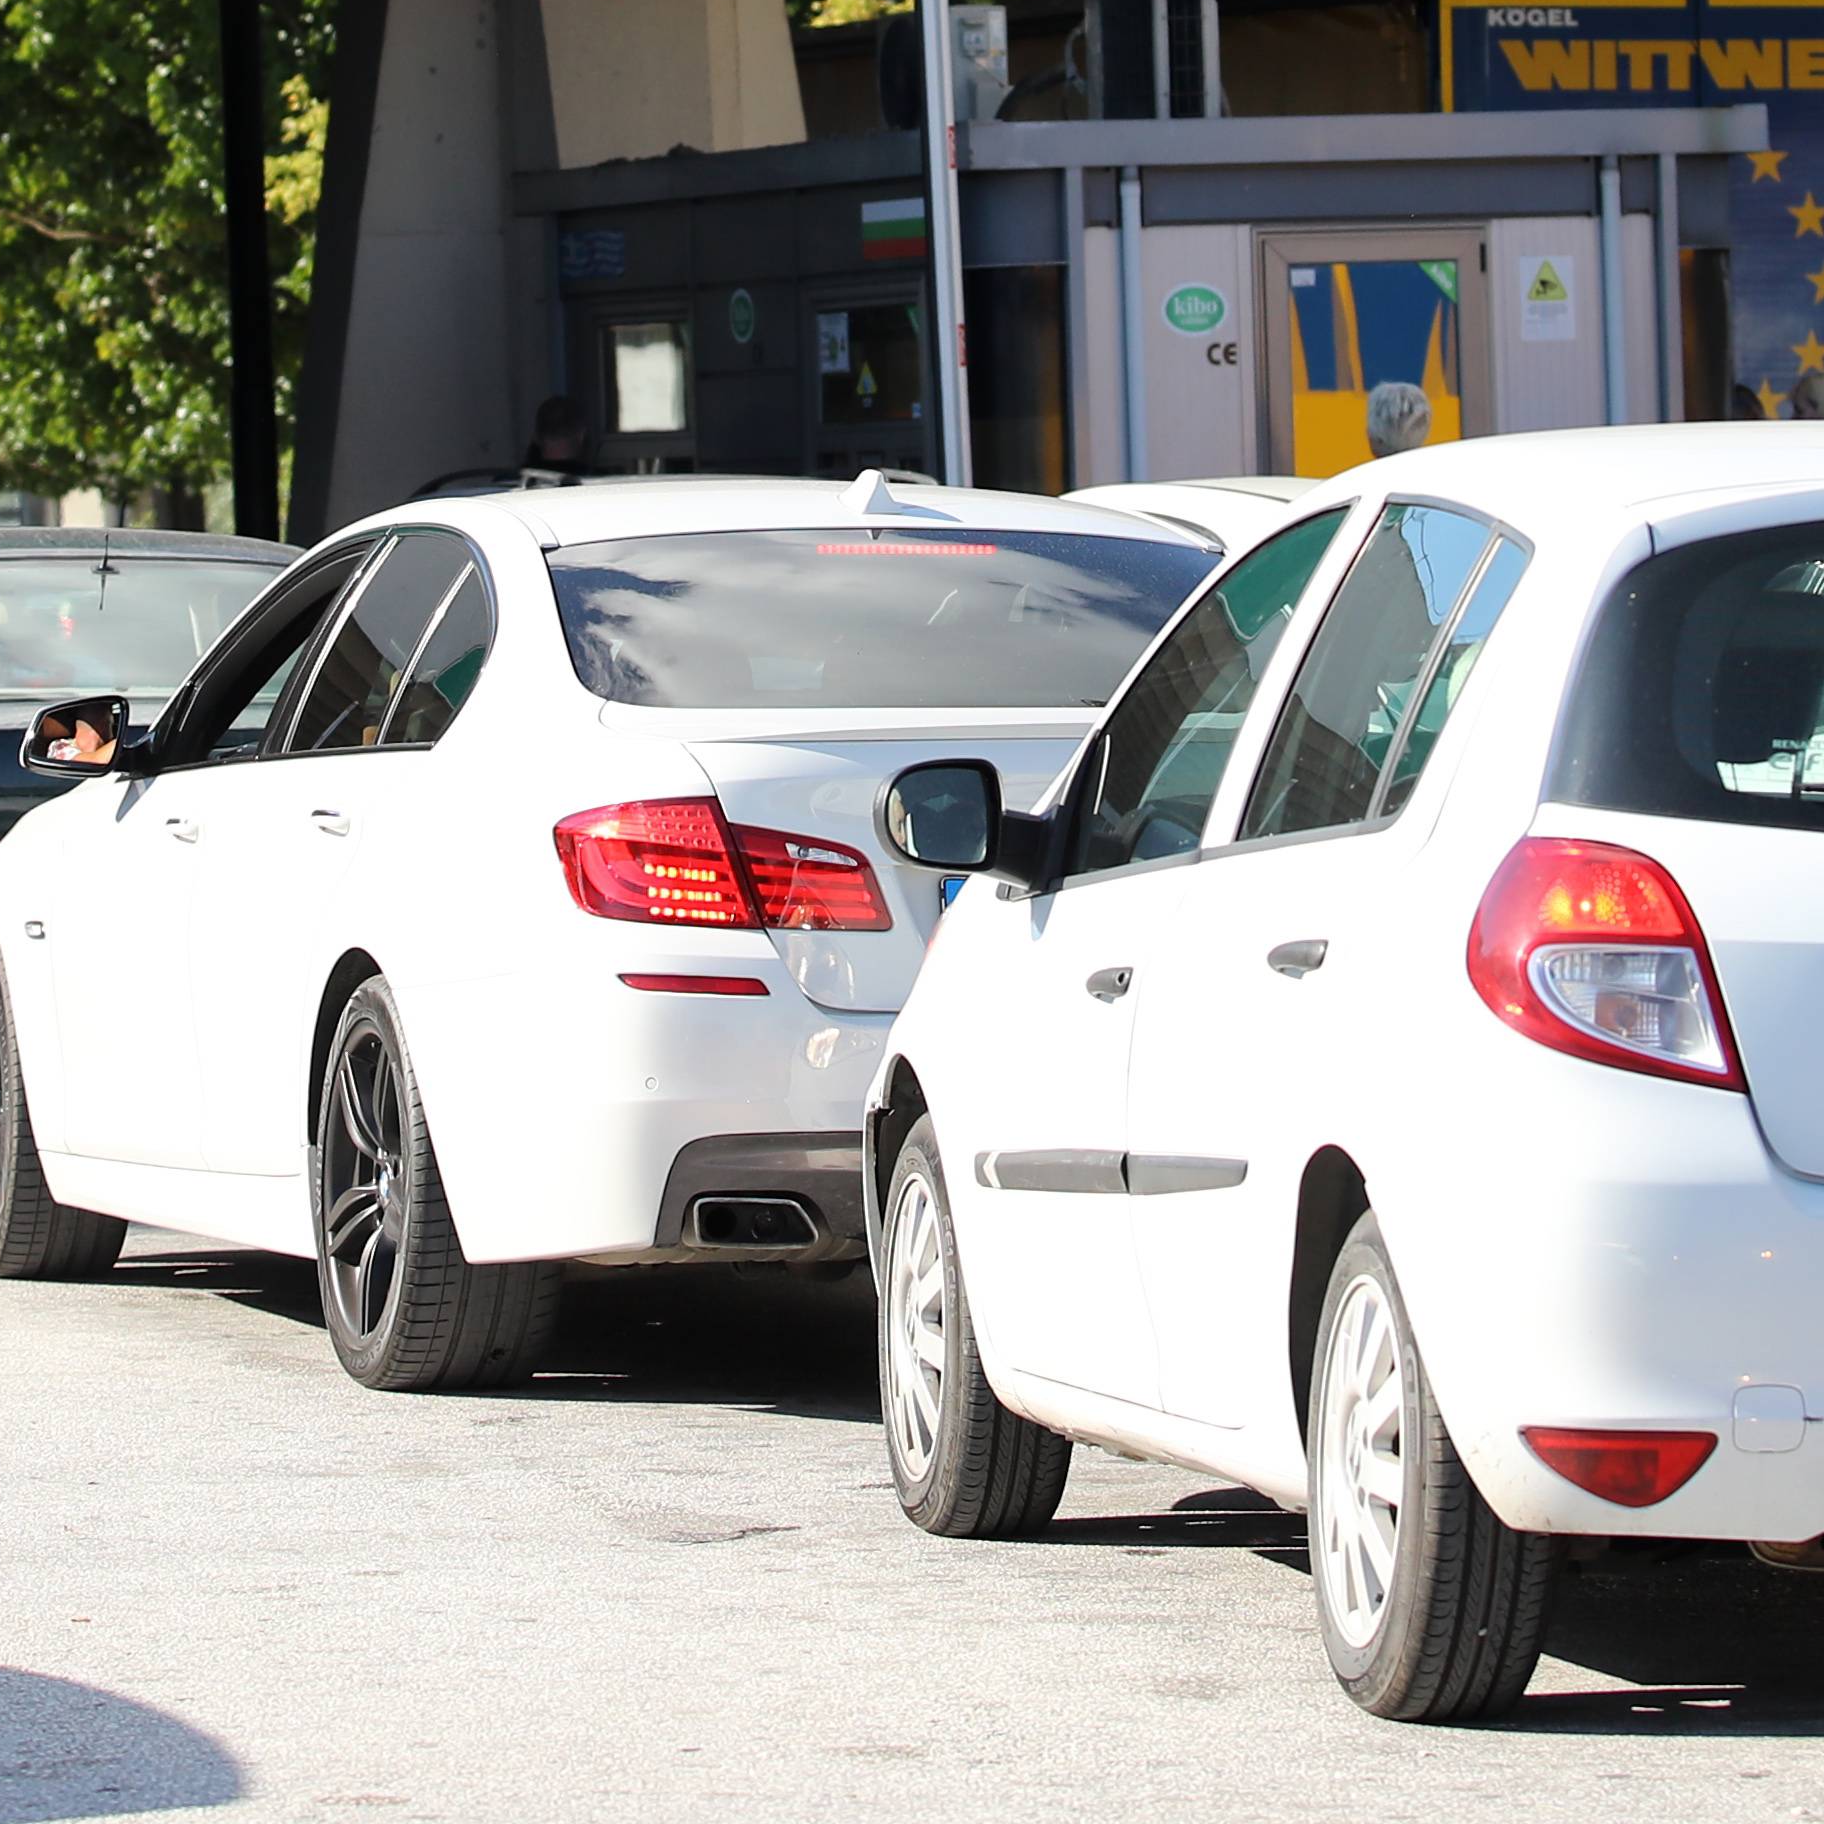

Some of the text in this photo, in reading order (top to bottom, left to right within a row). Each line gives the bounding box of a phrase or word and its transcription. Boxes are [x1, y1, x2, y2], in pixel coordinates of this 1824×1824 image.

[1486, 7, 1578, 28] KÖGEL
[1174, 295, 1218, 316] kibo
[1206, 342, 1238, 367] CE
